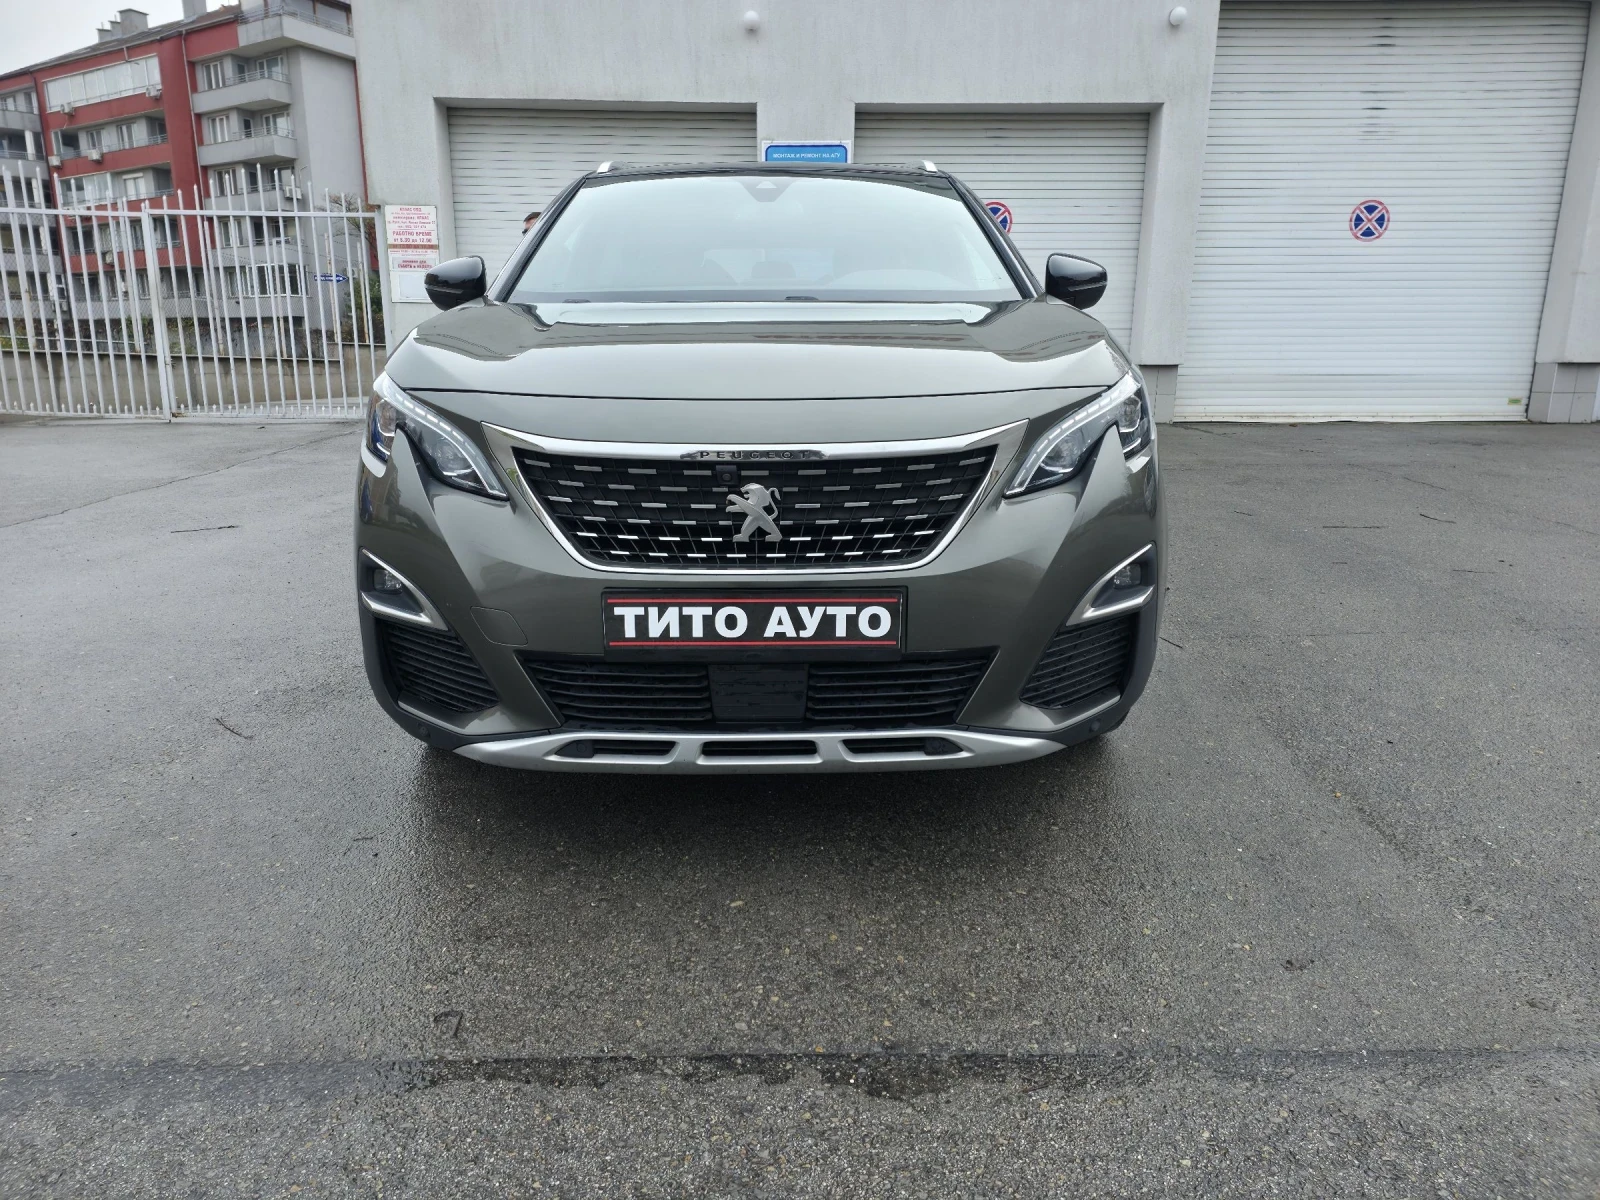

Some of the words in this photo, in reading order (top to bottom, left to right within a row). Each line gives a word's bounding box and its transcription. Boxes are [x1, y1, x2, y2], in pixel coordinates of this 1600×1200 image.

[700, 450, 810, 459] PEUGEOT
[613, 606, 748, 638] ТИТО
[763, 606, 892, 638] АУТО
